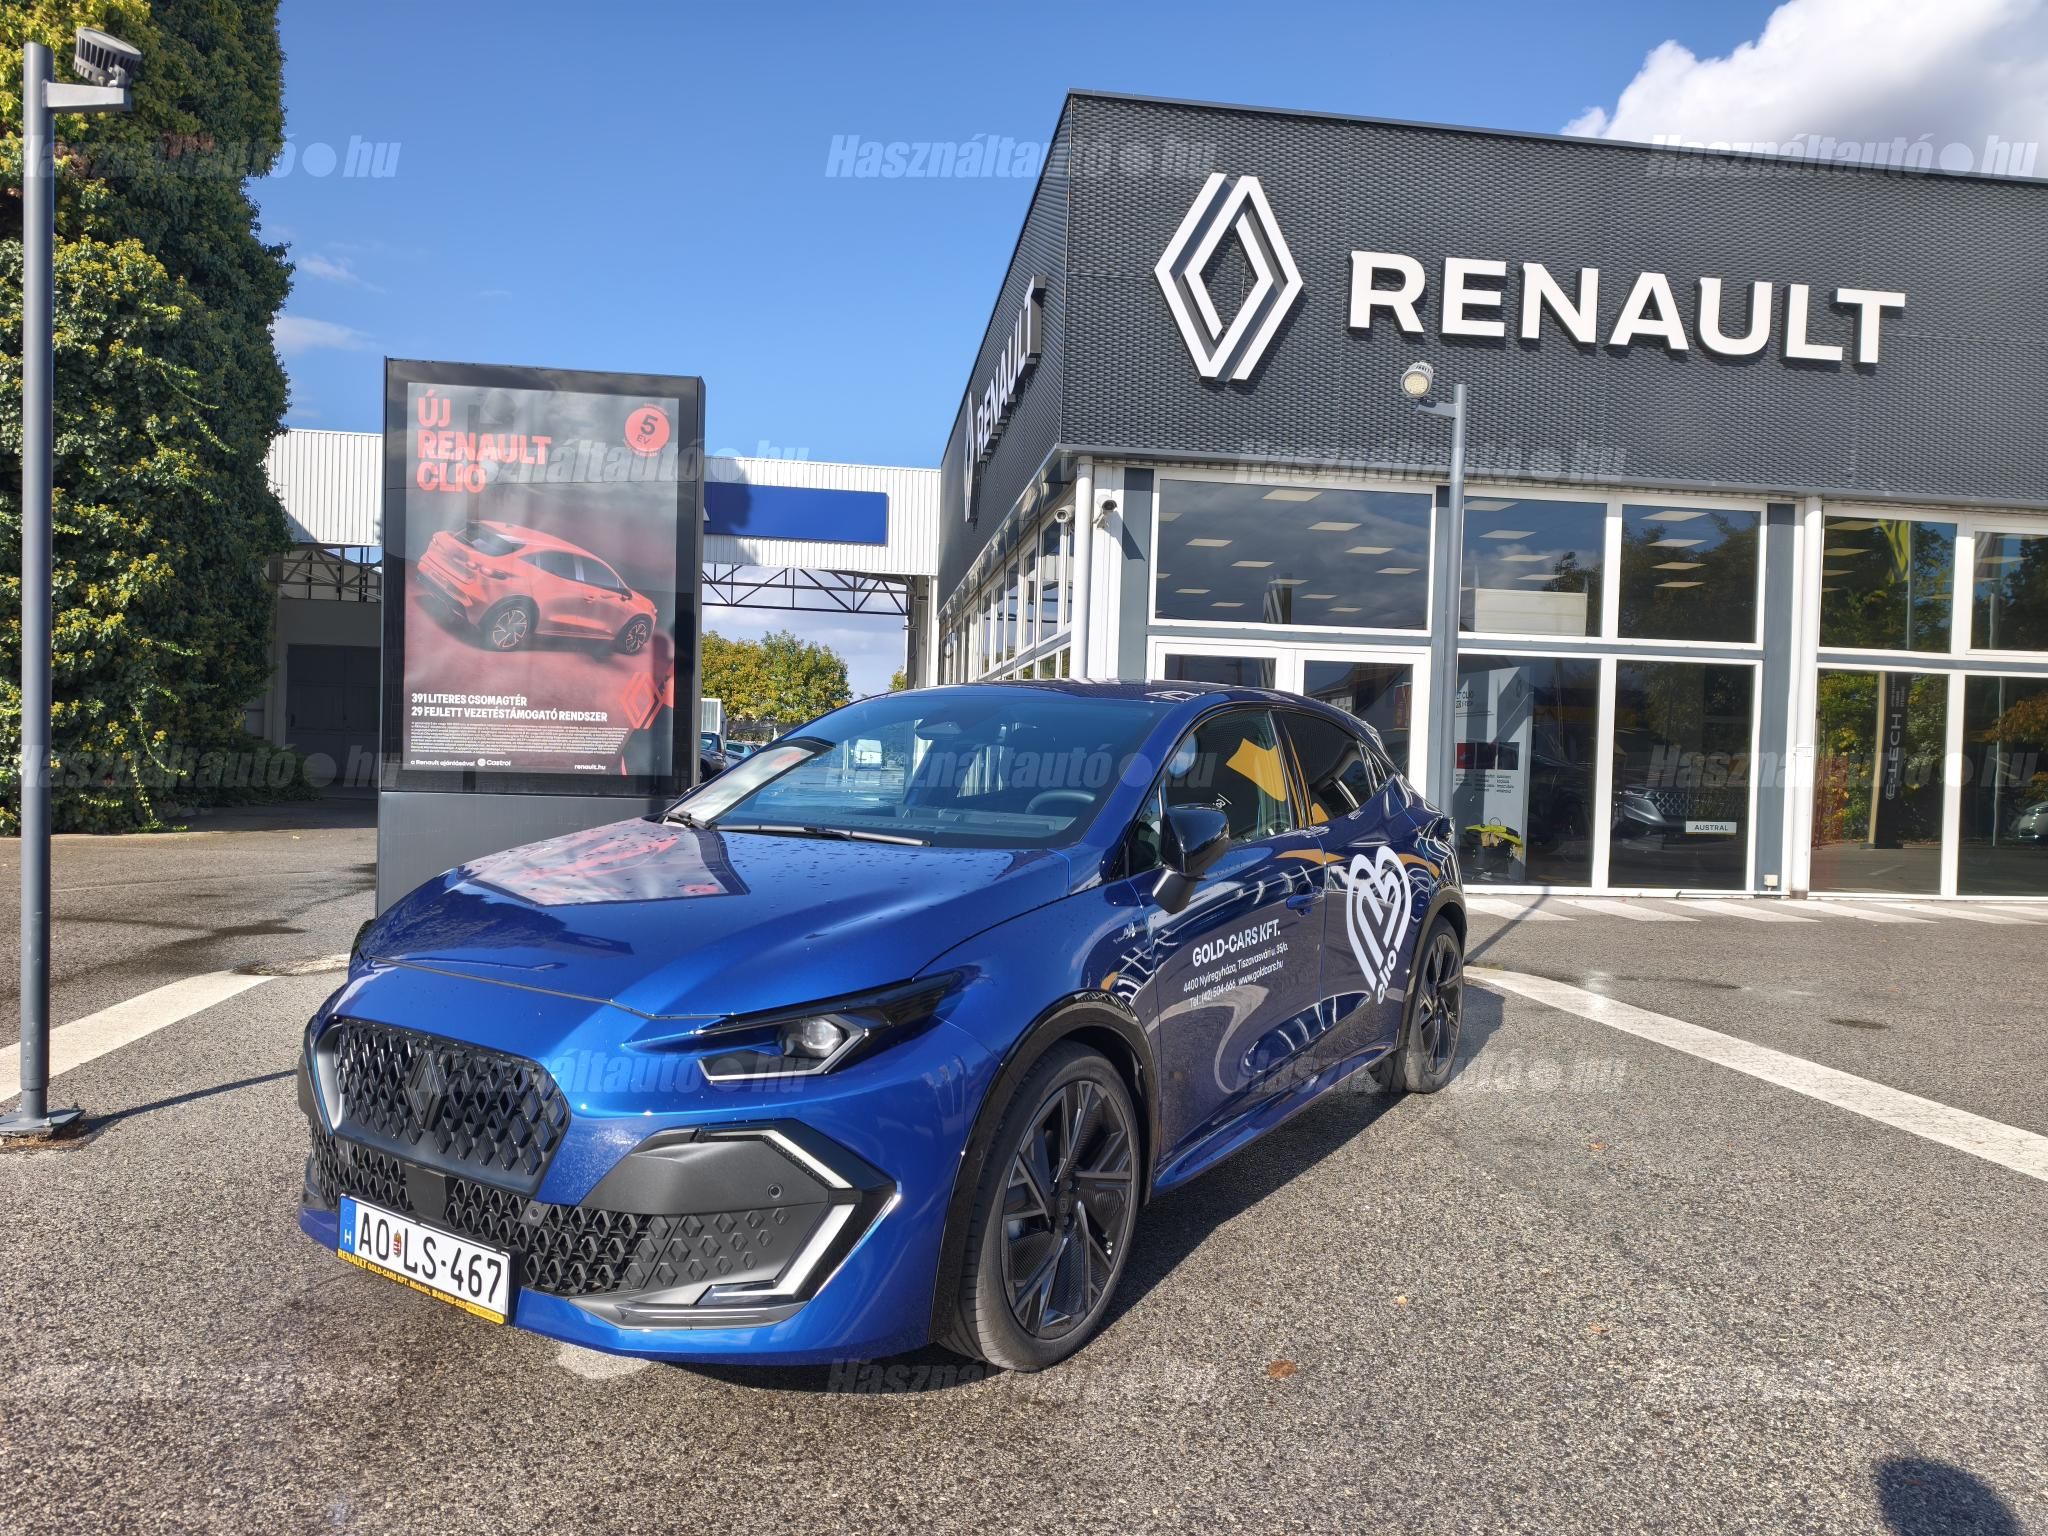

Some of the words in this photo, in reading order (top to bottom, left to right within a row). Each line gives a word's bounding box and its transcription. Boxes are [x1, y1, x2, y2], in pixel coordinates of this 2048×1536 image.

[1348, 250, 1906, 364] RENAULT
[977, 273, 1043, 462] RENAULT
[417, 389, 452, 428] ÚJ
[640, 414, 658, 435] 5
[417, 430, 552, 465] RENAULT
[416, 461, 487, 493] CLIO
[411, 693, 426, 704] 391
[427, 693, 466, 705] LITERES
[467, 694, 528, 706] CSOMAGTÉR
[411, 706, 423, 717] 29
[424, 706, 463, 718] FEJLETT
[464, 707, 558, 720] VEZETÉSTÁMOGATÓ
[558, 711, 608, 722] RENDSZER
[486, 759, 512, 767] Castrol
[1694, 824, 1729, 832] AUSTRAL
[1192, 926, 1258, 967] GOLD-CARS
[1259, 918, 1281, 942] KFT.
[1183, 977, 1199, 993] 4400
[1377, 949, 1397, 1005] clio
[343, 1229, 352, 1245] H
[359, 1212, 390, 1261] AO
[337, 1248, 367, 1269] RENAULT
[367, 1263, 397, 1281] GOLD-CARS
